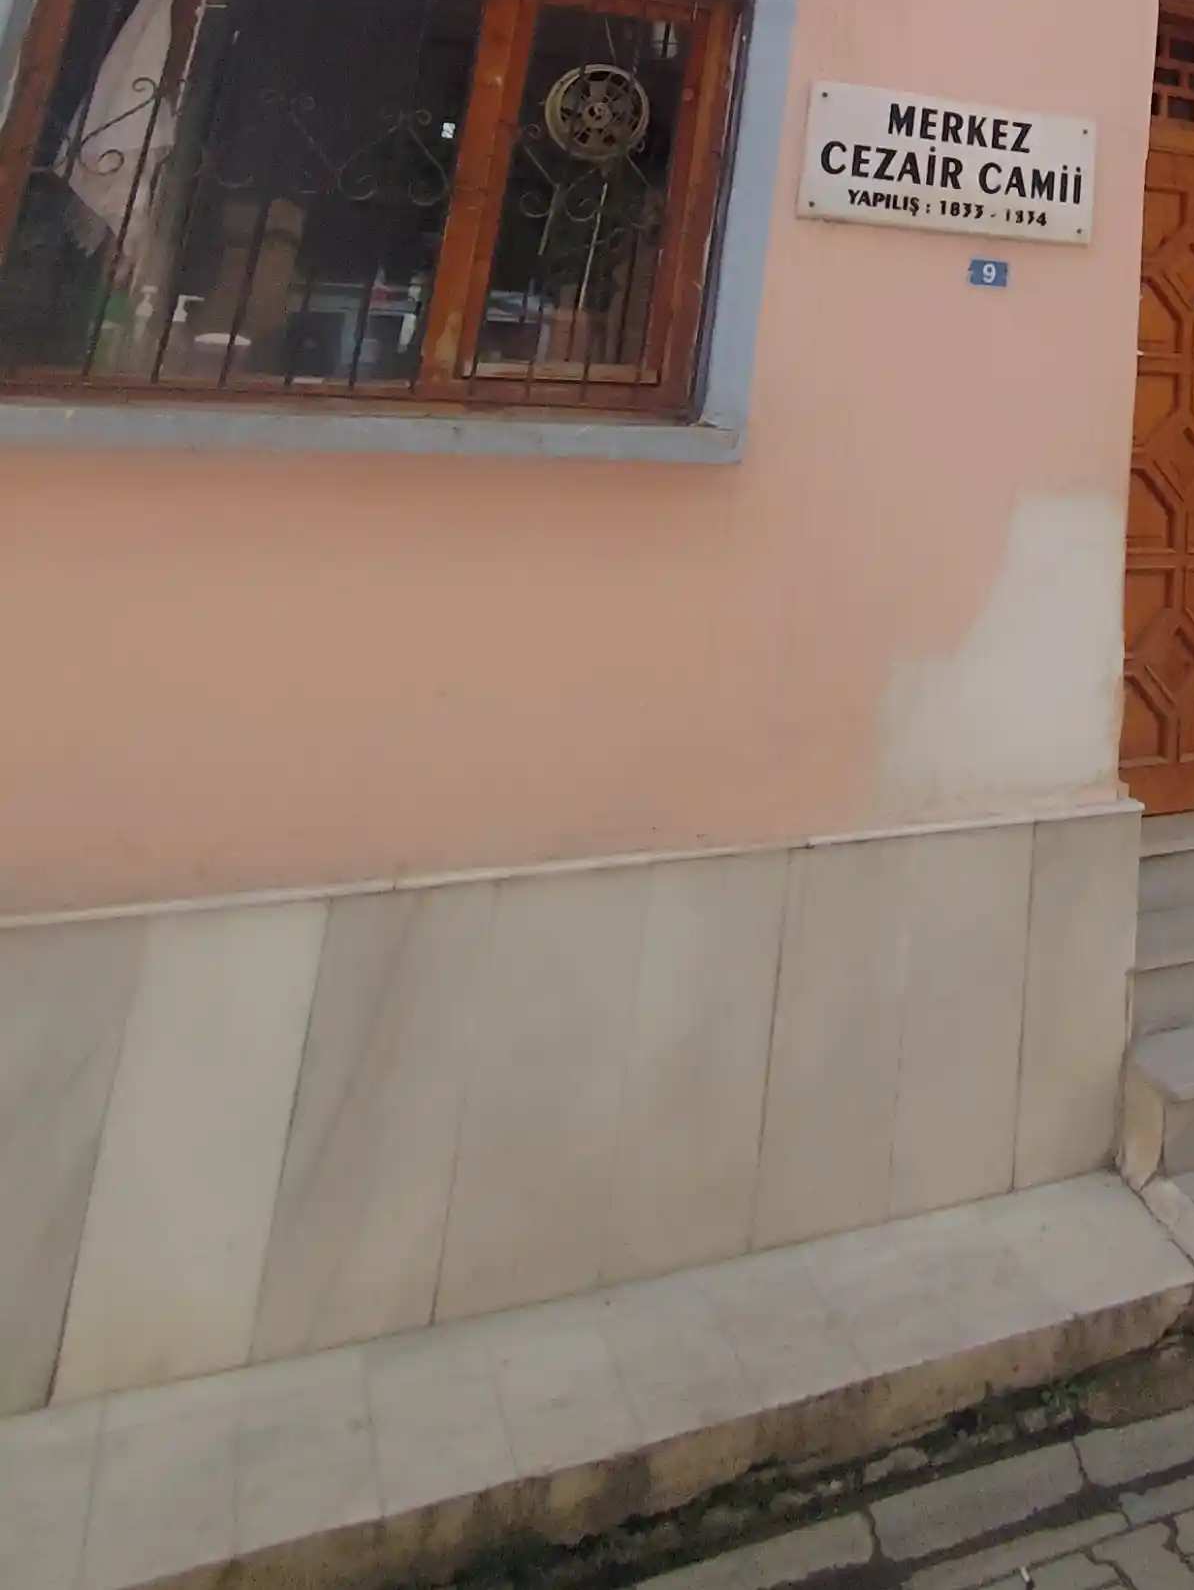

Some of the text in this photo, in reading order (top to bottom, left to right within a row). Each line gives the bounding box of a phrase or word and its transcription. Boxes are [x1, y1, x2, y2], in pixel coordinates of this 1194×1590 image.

[887, 103, 1033, 154] MERKEZ
[820, 140, 1083, 205] CEZAİR CAMİİ
[982, 263, 997, 284] 9
